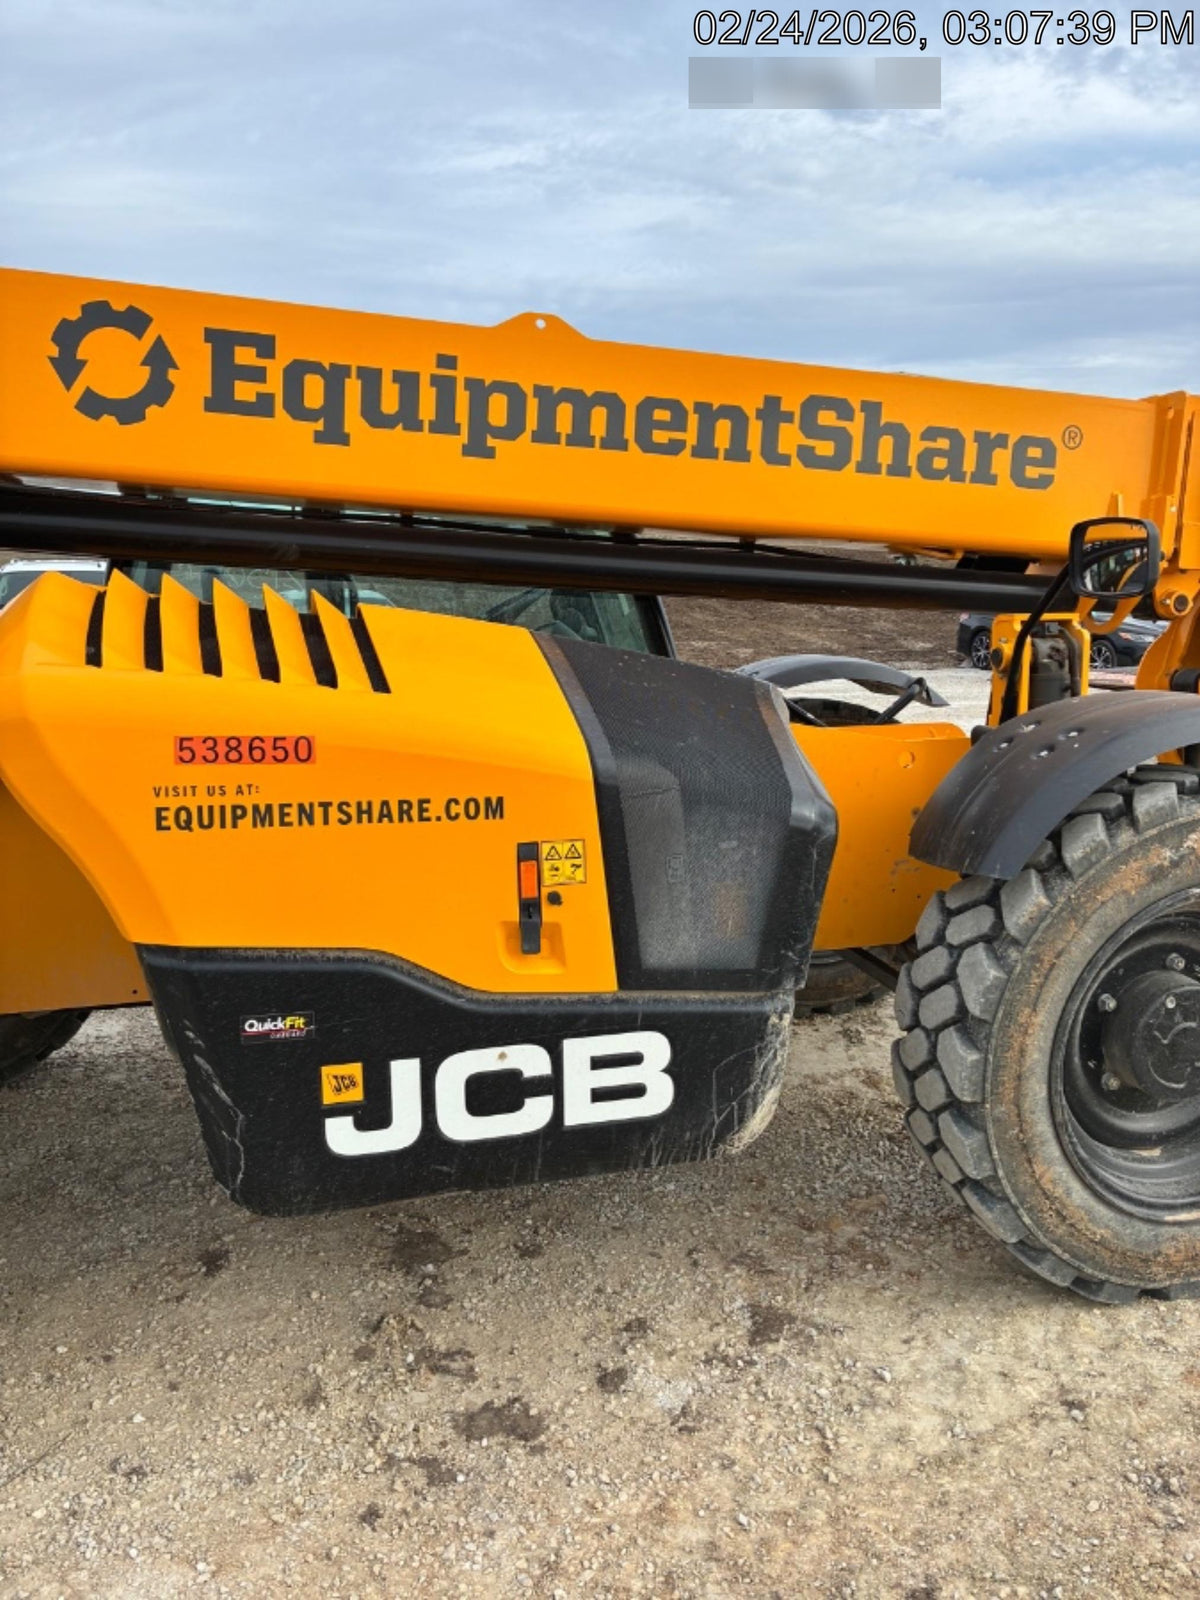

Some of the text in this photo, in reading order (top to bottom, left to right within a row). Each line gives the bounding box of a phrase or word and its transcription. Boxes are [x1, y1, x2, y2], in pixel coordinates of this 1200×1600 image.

[177, 736, 313, 764] 538650
[153, 783, 260, 798] VISIT US AT:
[155, 796, 505, 832] EQUIPMENTSHARE.COM
[244, 1016, 306, 1032] QuickFit
[324, 1030, 675, 1157] JCB
